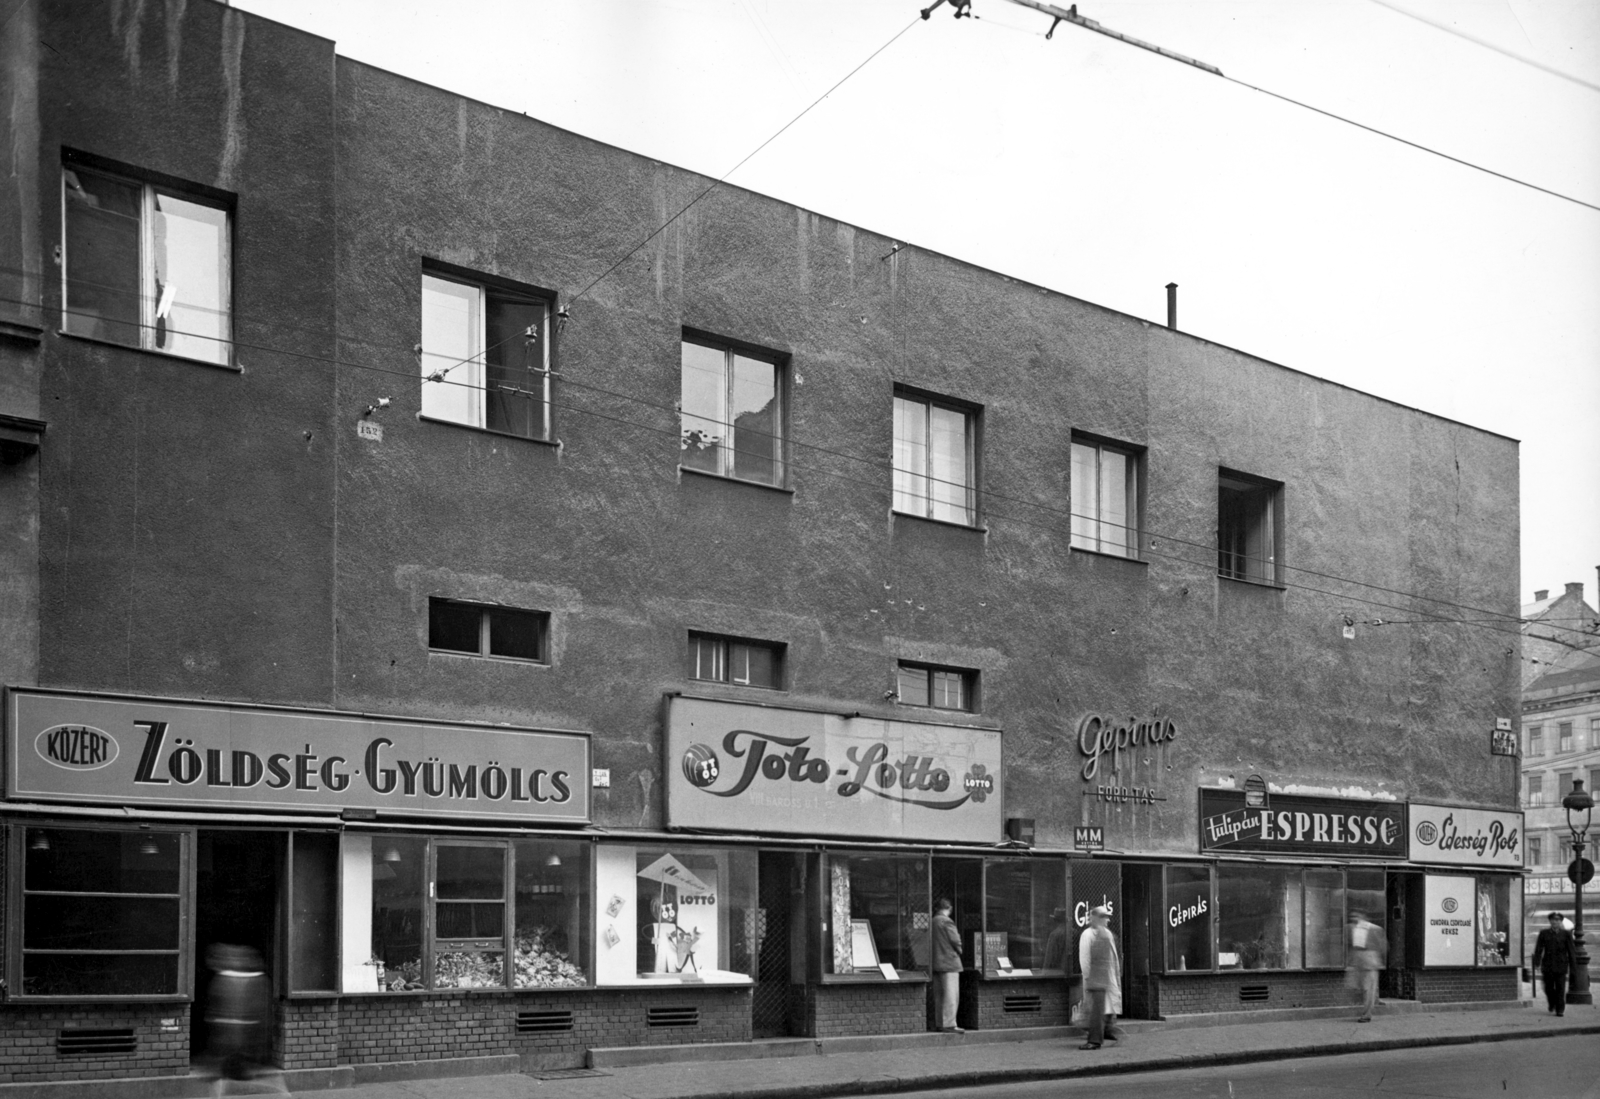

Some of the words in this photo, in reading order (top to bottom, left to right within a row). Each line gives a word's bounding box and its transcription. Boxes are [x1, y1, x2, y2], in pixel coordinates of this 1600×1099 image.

[47, 726, 109, 765] KÖZÉRT
[1076, 828, 1102, 841] MM
[1206, 811, 1261, 842] tulipán
[1259, 810, 1396, 846] ESPRESSO
[1439, 812, 1488, 857] Édesség
[680, 893, 715, 906] LOTTÓ
[1074, 893, 1114, 928] GÉÁS
[1169, 894, 1208, 928] GÉPIRÁS
